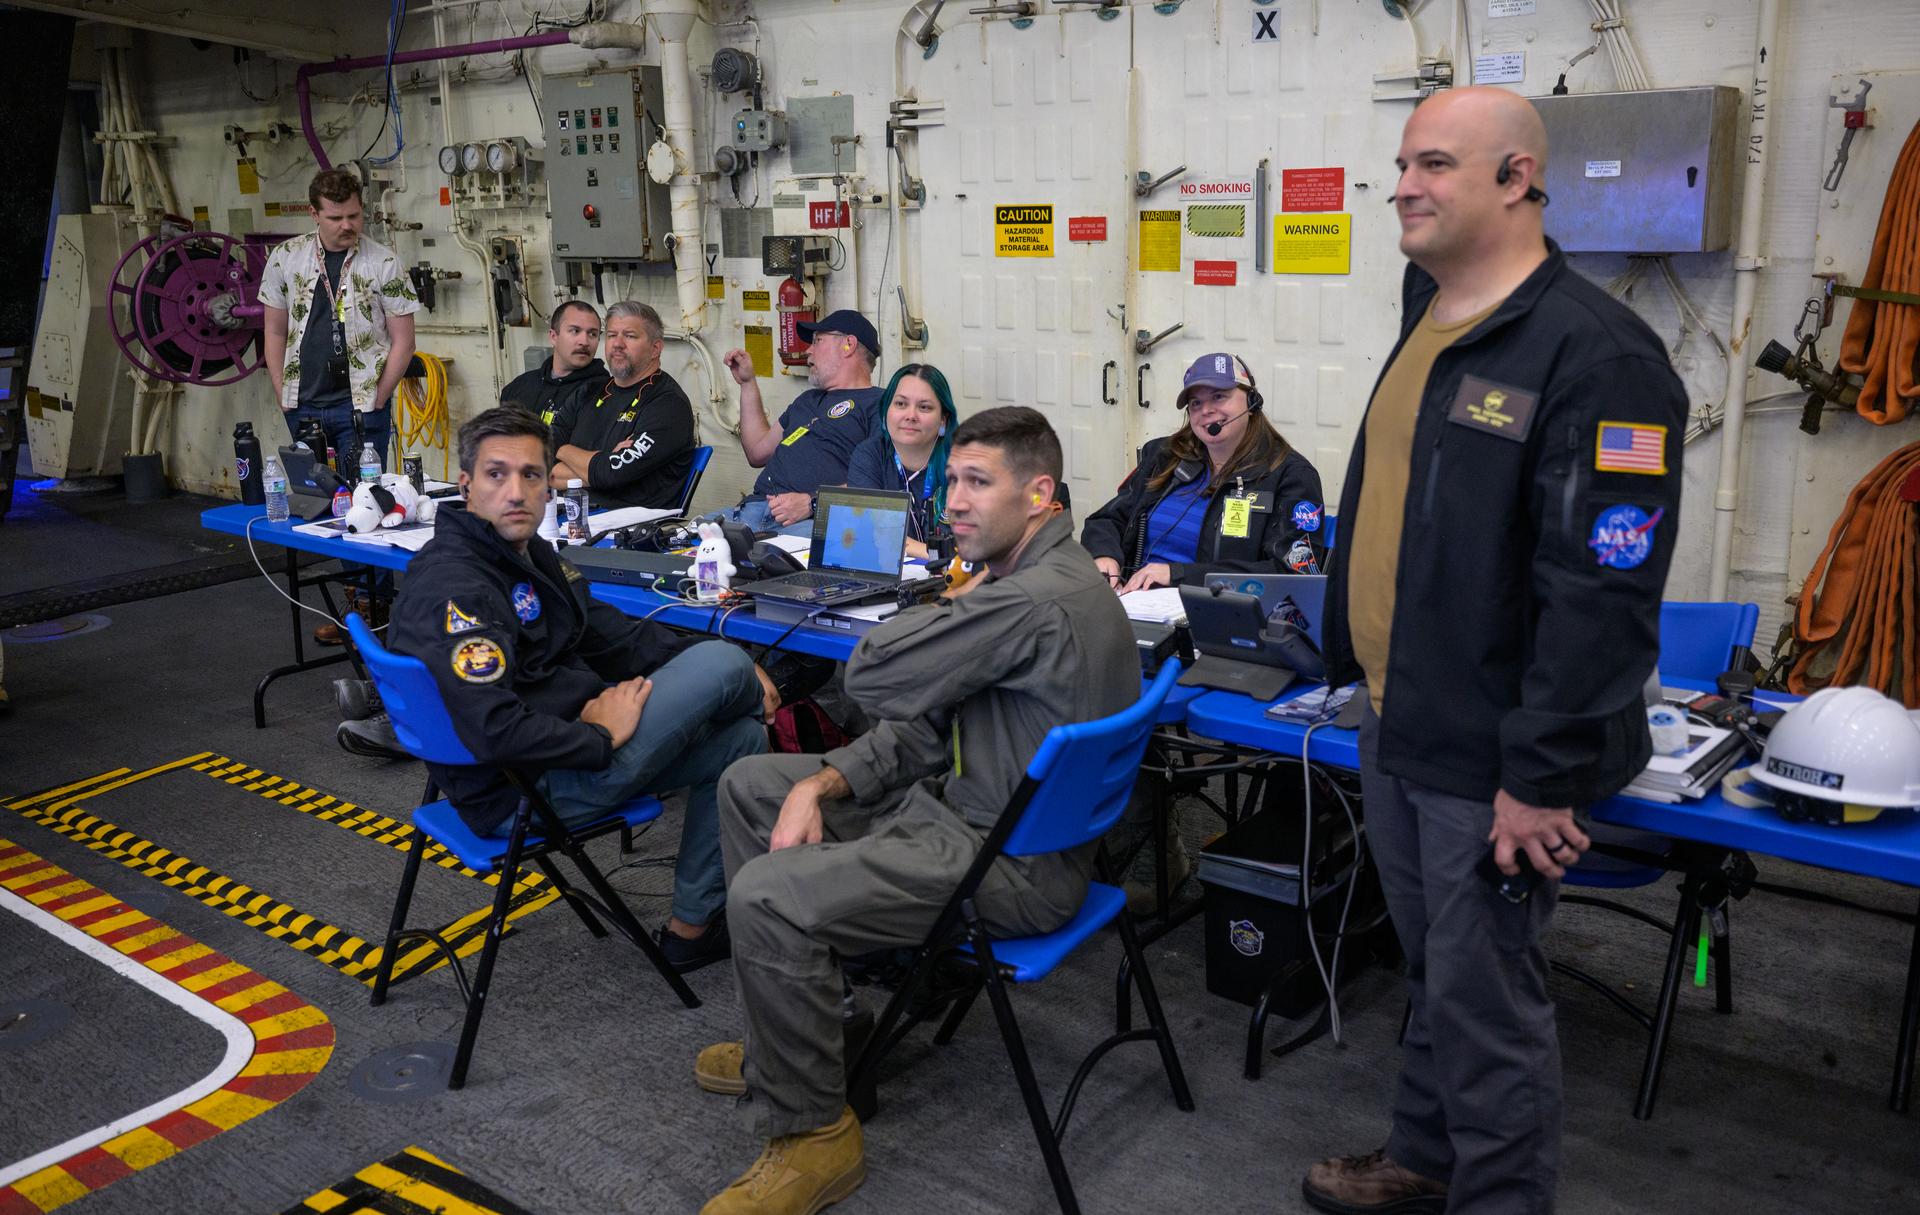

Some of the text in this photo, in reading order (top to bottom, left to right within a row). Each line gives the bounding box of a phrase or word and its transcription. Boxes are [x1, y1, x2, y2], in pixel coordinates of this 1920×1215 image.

[1255, 11, 1278, 40] X
[1754, 77, 1768, 96] VT
[1752, 104, 1766, 123] TK
[1181, 183, 1252, 194] NO SMOKING
[999, 209, 1049, 221] CAUTION
[1142, 211, 1179, 221] WARNING
[1004, 227, 1044, 235] HAZARDOUS
[1284, 224, 1340, 235] WARNING
[1000, 244, 1049, 252] STORAGE AREA
[706, 254, 717, 274] Y
[744, 292, 769, 300] CAUTION
[609, 431, 655, 470] COMET
[1295, 511, 1319, 522] NASA
[1597, 526, 1648, 552] NASA
